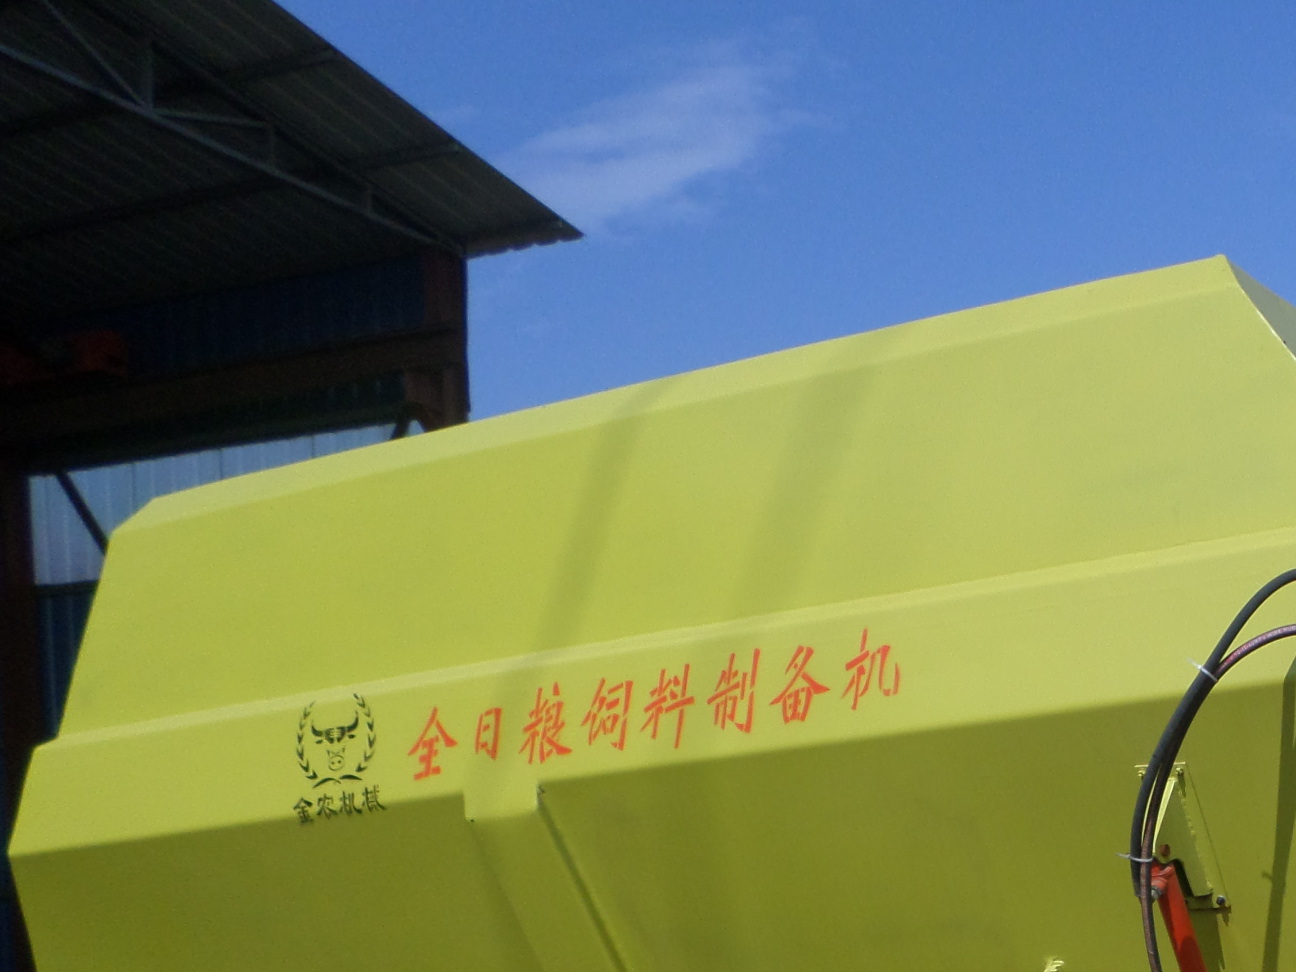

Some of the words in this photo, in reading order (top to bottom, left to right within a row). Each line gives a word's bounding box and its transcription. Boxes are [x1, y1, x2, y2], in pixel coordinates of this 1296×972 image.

[406, 628, 901, 781] 全日粮饲料制备机
[292, 784, 388, 826] 金农机械
